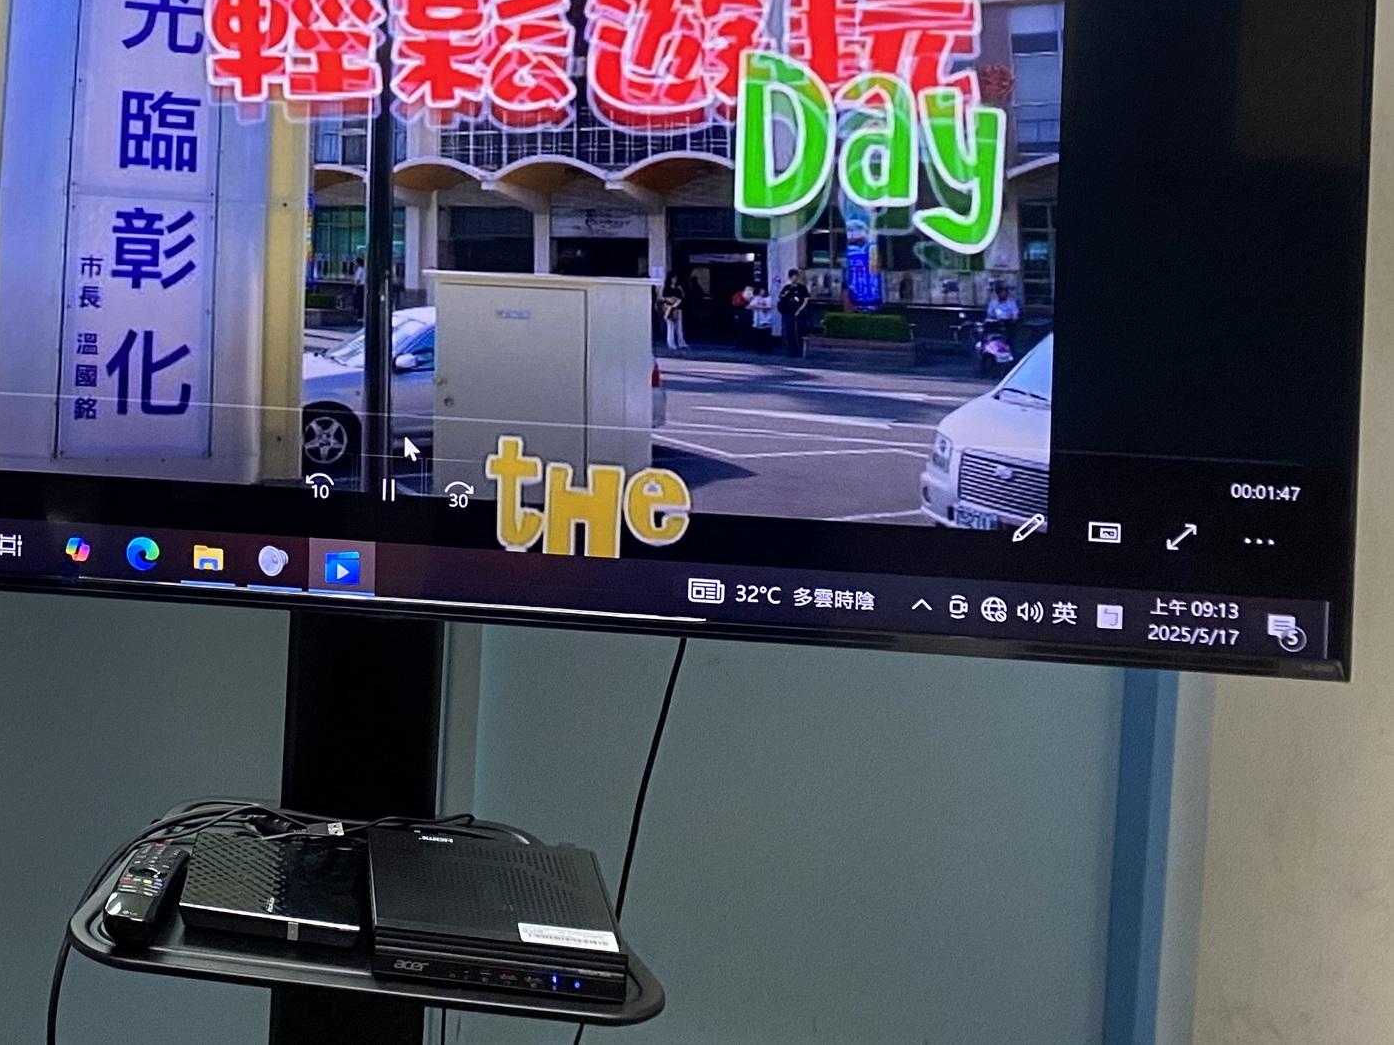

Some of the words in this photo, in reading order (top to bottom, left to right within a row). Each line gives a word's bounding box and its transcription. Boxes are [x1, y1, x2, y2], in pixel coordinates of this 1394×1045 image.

[735, 50, 1007, 255] Day
[78, 255, 104, 308] 市長
[312, 484, 330, 500] 10
[448, 492, 469, 509] 30
[1230, 482, 1302, 502] 00:01:47
[793, 586, 876, 612] 多雲時陰
[1149, 597, 1187, 618] 上午
[1190, 600, 1240, 620] 09:13
[1051, 601, 1079, 626] 英
[1147, 624, 1241, 646] 2025/5/17
[393, 958, 429, 973] acer
